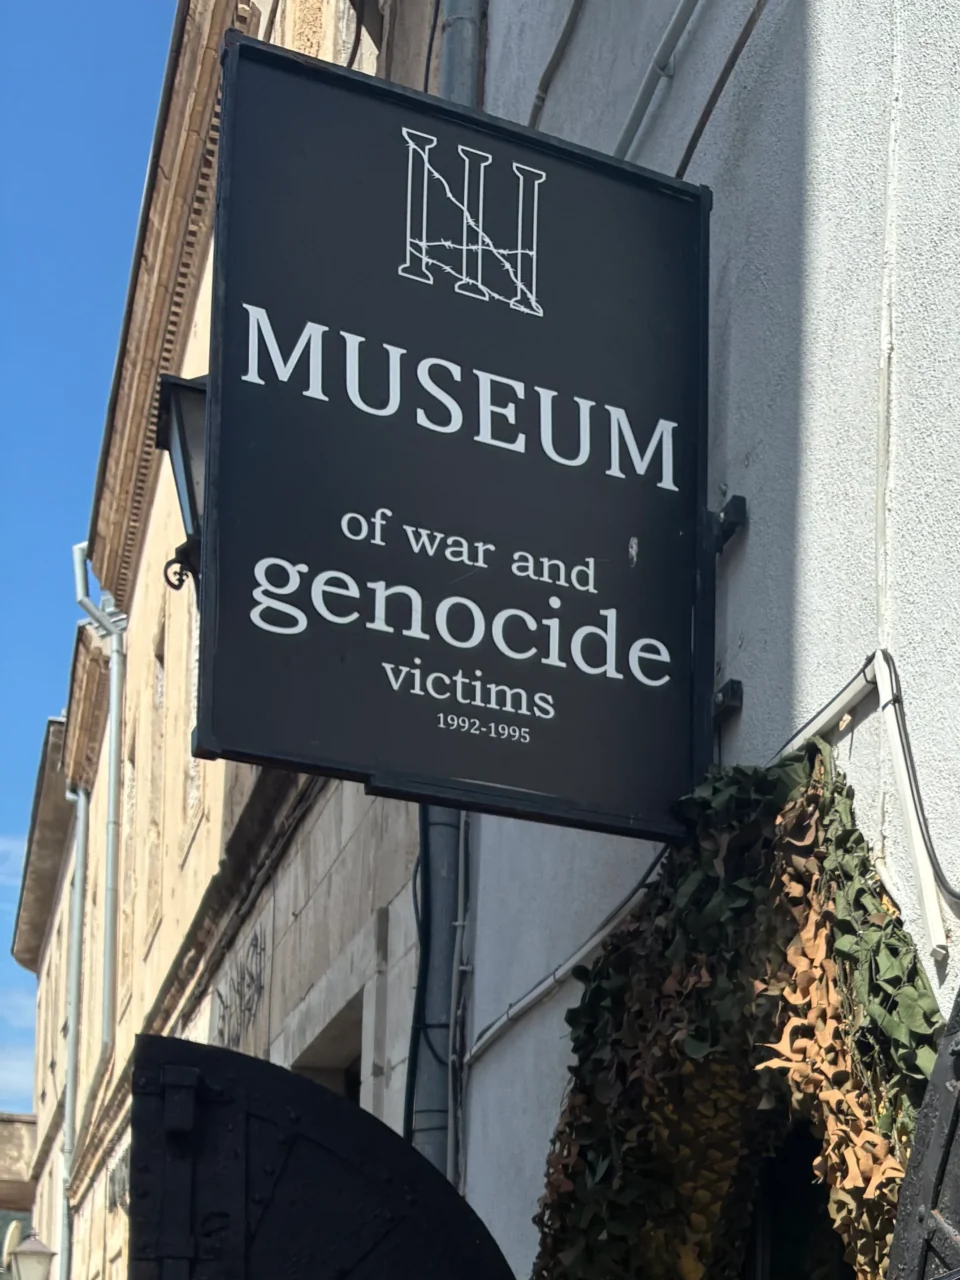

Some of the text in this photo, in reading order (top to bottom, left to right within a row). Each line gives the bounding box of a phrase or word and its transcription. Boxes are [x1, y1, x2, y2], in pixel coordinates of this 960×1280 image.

[240, 302, 679, 492] MUSEUM
[340, 507, 599, 594] of war and
[249, 556, 671, 687] genocide
[381, 657, 555, 720] victims
[436, 712, 531, 744] 1992-1995
